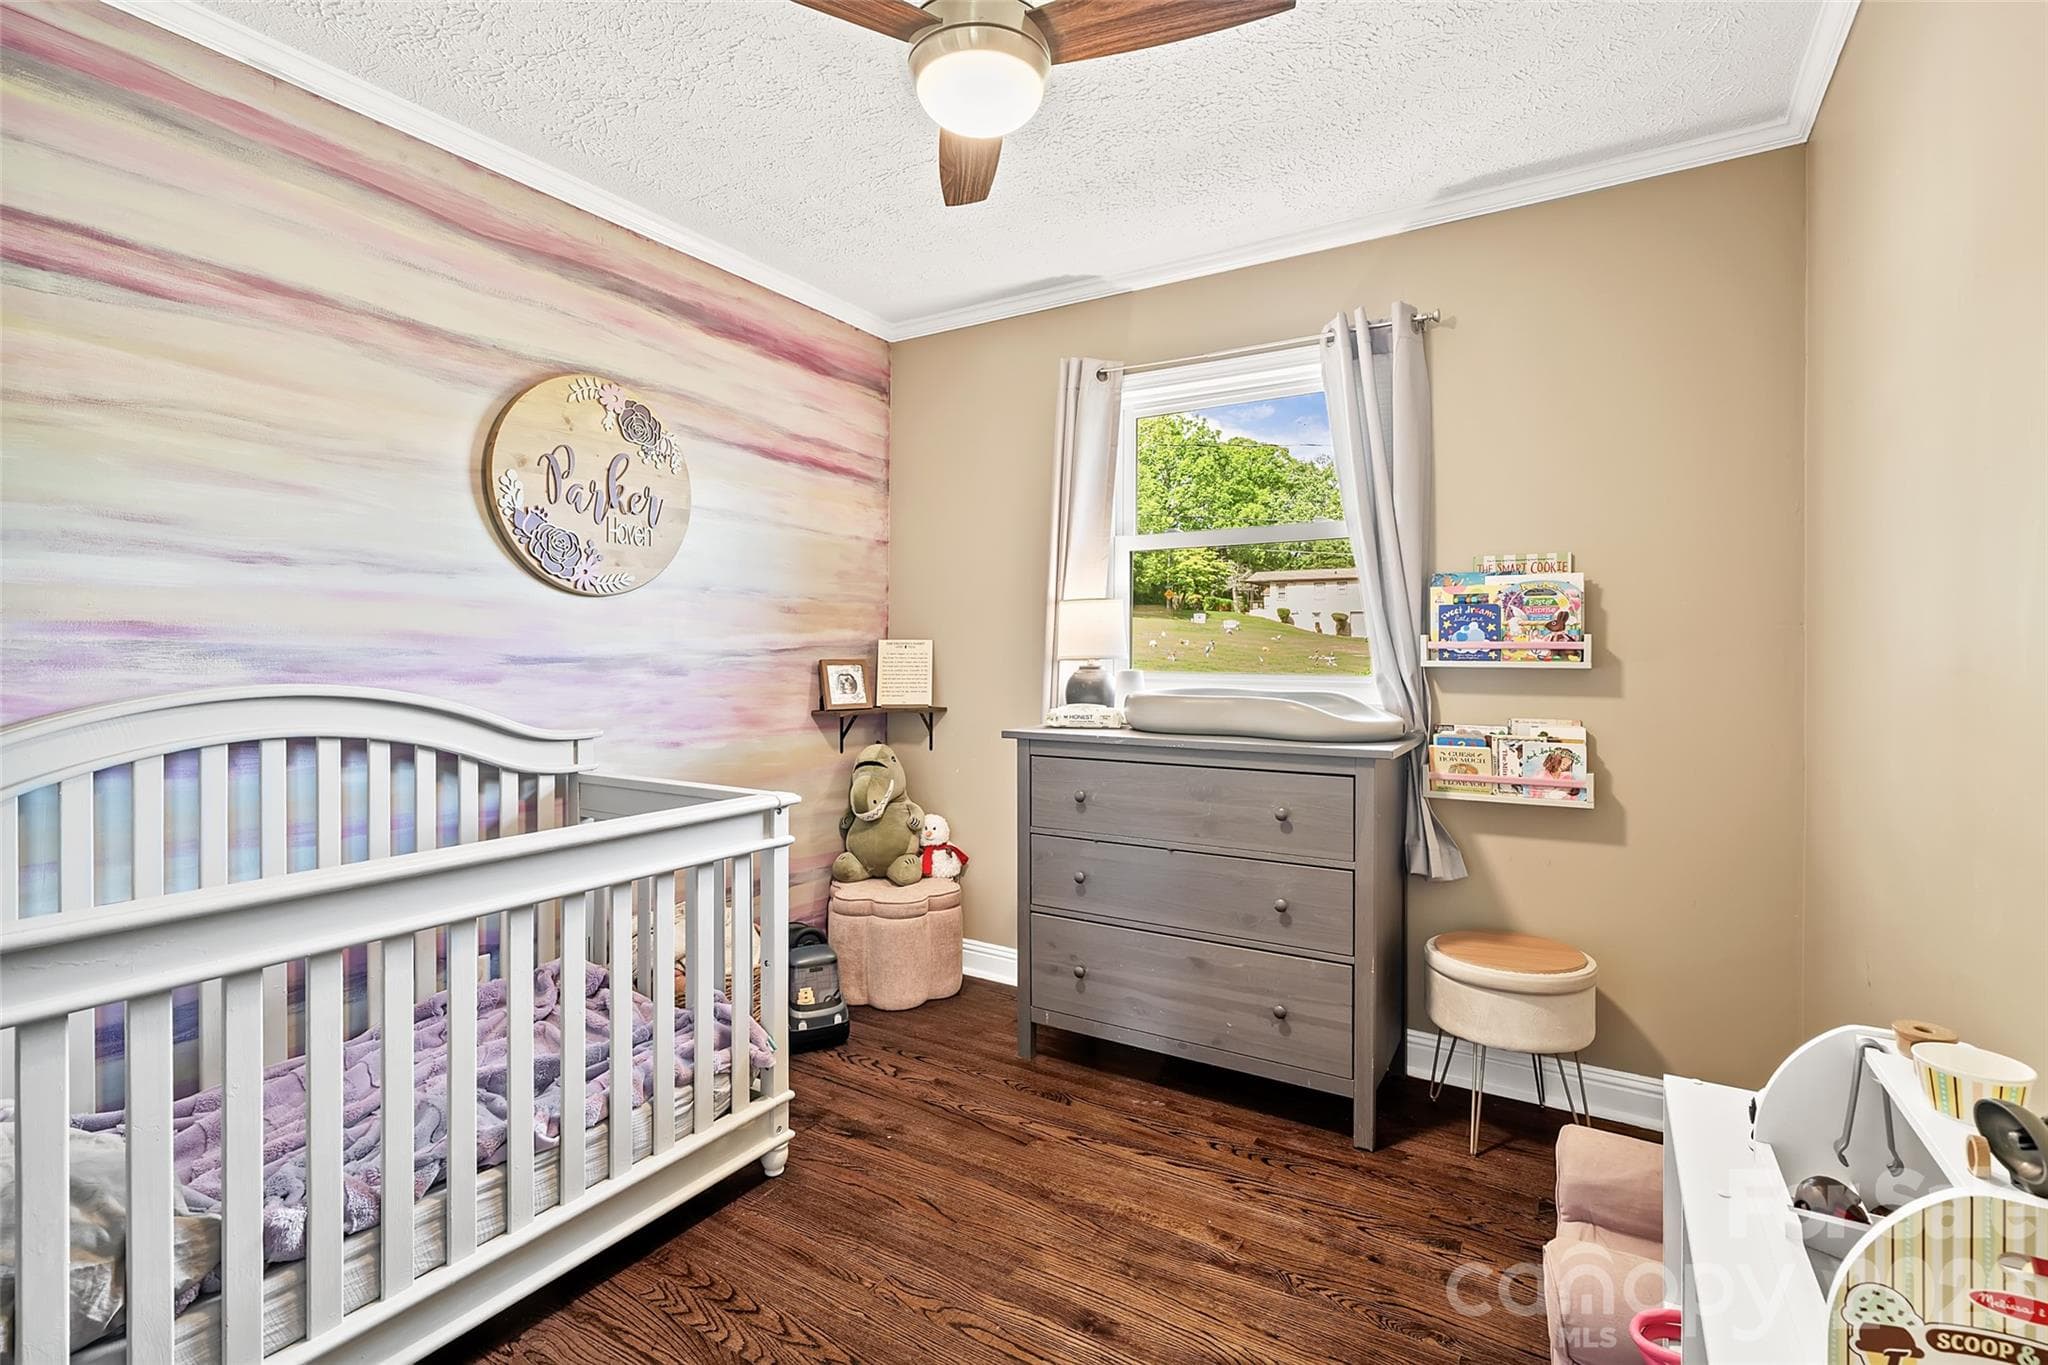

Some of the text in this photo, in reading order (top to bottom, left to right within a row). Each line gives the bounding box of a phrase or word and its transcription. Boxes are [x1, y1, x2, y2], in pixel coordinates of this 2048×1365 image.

[537, 444, 664, 529] Parker
[606, 515, 653, 548] Haven
[1477, 564, 1493, 573] THE
[1497, 562, 1527, 573] SMART
[1530, 560, 1568, 574] COOKIE
[1978, 1293, 2035, 1315] Melissa
[1936, 1332, 2041, 1365] SCOOP &
